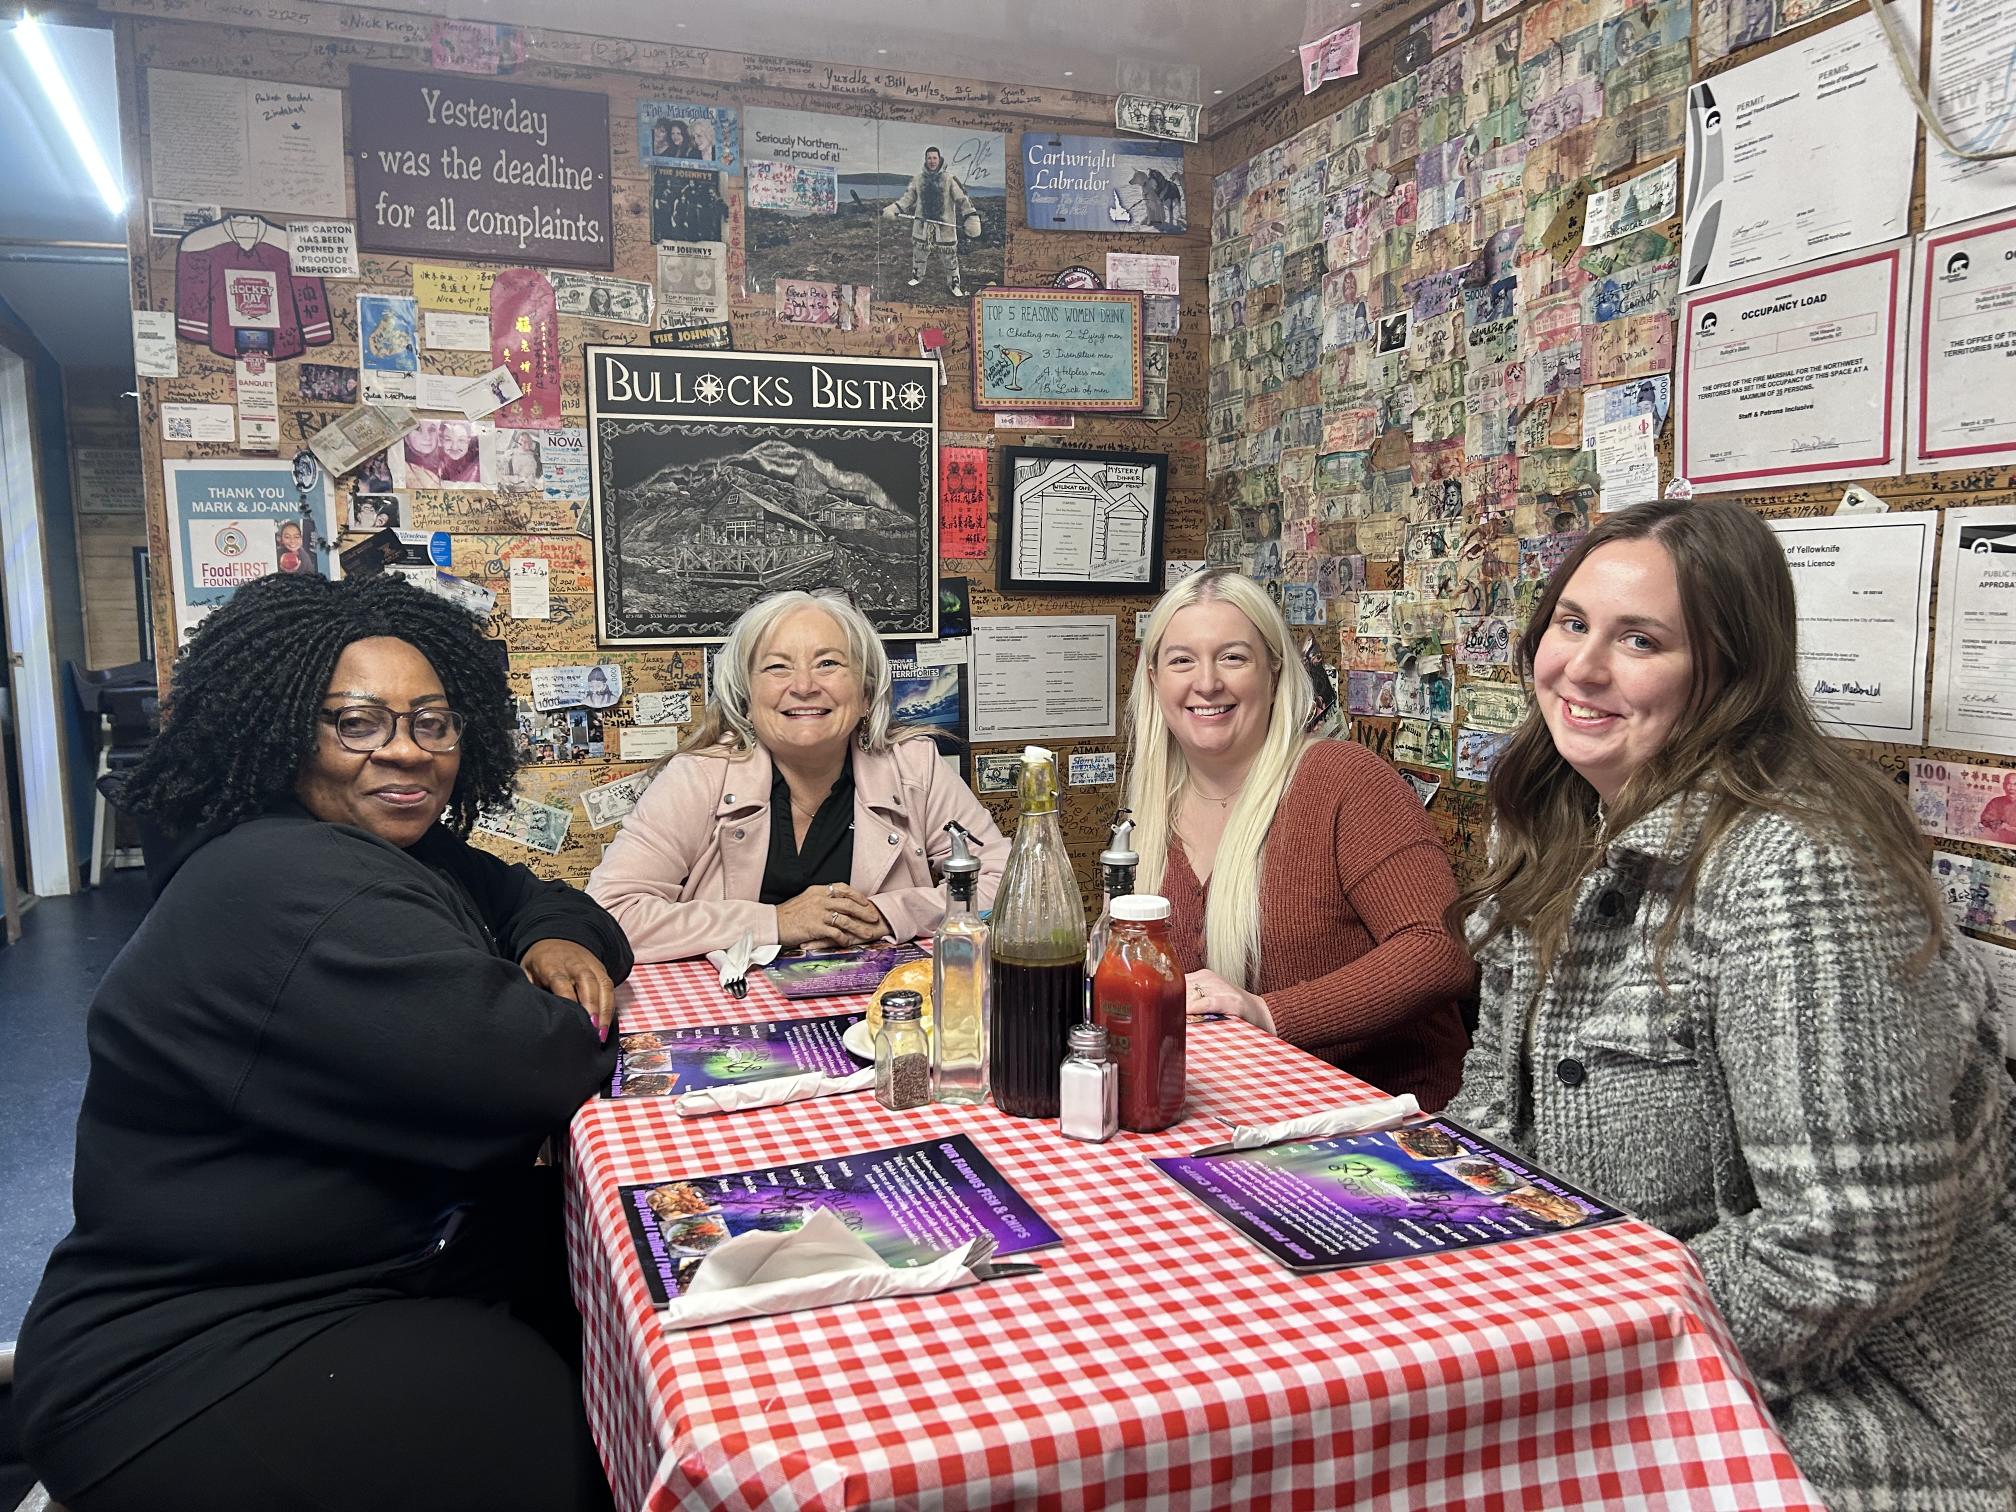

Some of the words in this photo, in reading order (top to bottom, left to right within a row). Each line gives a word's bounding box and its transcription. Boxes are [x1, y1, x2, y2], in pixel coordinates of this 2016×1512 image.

[351, 14, 380, 30] Nick
[1818, 63, 1850, 81] PERMIS
[1736, 95, 1765, 113] PERMIT
[421, 88, 548, 146] Yesterday
[643, 104, 664, 118] The
[666, 104, 717, 123] Marigolds
[755, 131, 795, 149] Seriously
[797, 135, 848, 151] Northern...
[773, 147, 790, 157] and
[792, 148, 817, 162] proud
[818, 150, 829, 161] of
[830, 152, 840, 162] it!
[1028, 145, 1116, 173] Cartwright
[378, 150, 431, 177] was
[441, 146, 482, 181] the
[493, 149, 594, 191] deadline
[1030, 169, 1110, 192] Labrador
[375, 191, 415, 226] for
[426, 197, 456, 231] all
[466, 205, 604, 248] complaints.
[289, 225, 309, 233] THIS
[313, 225, 352, 233] CARTON
[299, 236, 320, 244] HAS
[322, 236, 344, 244] BEEN
[297, 245, 334, 254] OPENED
[337, 246, 349, 254] BY
[301, 255, 347, 264] PRODUCE
[295, 266, 357, 275] INSPECTORS.
[231, 284, 275, 296] HOCKEY
[242, 293, 263, 304] DAY
[987, 305, 1004, 321] TOP
[1009, 306, 1016, 321] 5
[1021, 306, 1059, 323] REASONS
[1064, 307, 1096, 323] WOMEN
[1100, 308, 1125, 324] DRINK
[1741, 301, 1799, 321] OCCUPANCY
[1800, 293, 1827, 307] LOAD
[653, 334, 673, 344] THE
[678, 326, 729, 342] JOHNNYS
[1006, 327, 1042, 341] Cheating
[1044, 331, 1061, 339] men
[1078, 329, 1107, 344] Lying
[1107, 333, 1123, 341] men
[1950, 339, 1965, 348] THE
[1966, 335, 1993, 347] OFFICE
[1995, 332, 2008, 341] OF
[1943, 344, 1993, 358] TERRITORIES
[1994, 342, 2011, 351] HAS
[1054, 366, 1090, 378] Helpless
[1090, 369, 1106, 377] men
[1702, 384, 1712, 392] THE
[1714, 381, 1732, 391] OFFICE
[1753, 375, 1766, 383] FIRE
[1767, 371, 1795, 381] MARSHAL
[1796, 368, 1809, 376] FOR
[1810, 365, 1822, 373] THE
[1823, 358, 1864, 371] NORTHWEST
[238, 379, 274, 388] BANQUET
[605, 357, 794, 407] BULLOCKS
[811, 366, 928, 412] BISTRO
[1054, 384, 1081, 395] Lack
[1081, 384, 1092, 395] of
[1698, 389, 1731, 400] TERRITORIES
[1732, 386, 1743, 394] HAS
[1743, 383, 1754, 391] SET
[1755, 382, 1767, 390] THE
[1768, 376, 1804, 388] OCCUPANCY
[1805, 374, 1814, 382] OF
[1815, 372, 1829, 380] THIS
[1830, 368, 1852, 378] SPACE
[1852, 366, 1862, 374] AT
[1740, 392, 1766, 401] MAXIMUM
[1738, 411, 1753, 420] Staff
[1760, 407, 1784, 418] Patrons
[1784, 403, 1814, 414] Inclusive
[547, 437, 584, 448] NOVA
[1107, 466, 1139, 475] MYSTERY
[208, 487, 255, 499] THANK
[257, 487, 285, 499] YOU
[1054, 483, 1077, 491] WILDCAT
[192, 502, 233, 513] MARK
[236, 502, 248, 513] &
[250, 502, 302, 513] JO-ANN
[456, 518, 480, 526] came
[1787, 546, 1795, 554] of
[1796, 544, 1840, 554] Yellowknife
[202, 562, 269, 578] FoodFIRST
[1807, 560, 1836, 568] Licence
[1983, 570, 2010, 578] PUBLIC
[891, 668, 940, 678] TERRITORIES
[1915, 762, 1946, 782] 100
[1960, 770, 2000, 783] 中華民國
[1918, 818, 1938, 828] 100
[1426, 1122, 1463, 1137] Fried
[939, 1142, 955, 1159] OUR
[1452, 1136, 1485, 1149] Pan
[1481, 1152, 1533, 1174] Grilled
[788, 1168, 802, 1177] Lake
[793, 1176, 808, 1185] Trout
[951, 1156, 986, 1192] FAMOUS
[1175, 1164, 1214, 1186] CHIPS
[1204, 1185, 1224, 1193] &
[1528, 1177, 1573, 1195] Fried
[629, 1189, 651, 1209] Deep
[977, 1187, 1002, 1207] FISH
[1213, 1192, 1247, 1210] FISH
[1560, 1194, 1610, 1214] Deep
[638, 1207, 657, 1226] Fried
[992, 1205, 1009, 1216] &
[1000, 1214, 1031, 1240] CHIPS
[1237, 1210, 1292, 1242] FAMOUS
[645, 1231, 667, 1257] Grilled
[1281, 1241, 1318, 1260] OUR
[655, 1261, 673, 1279] Pan
